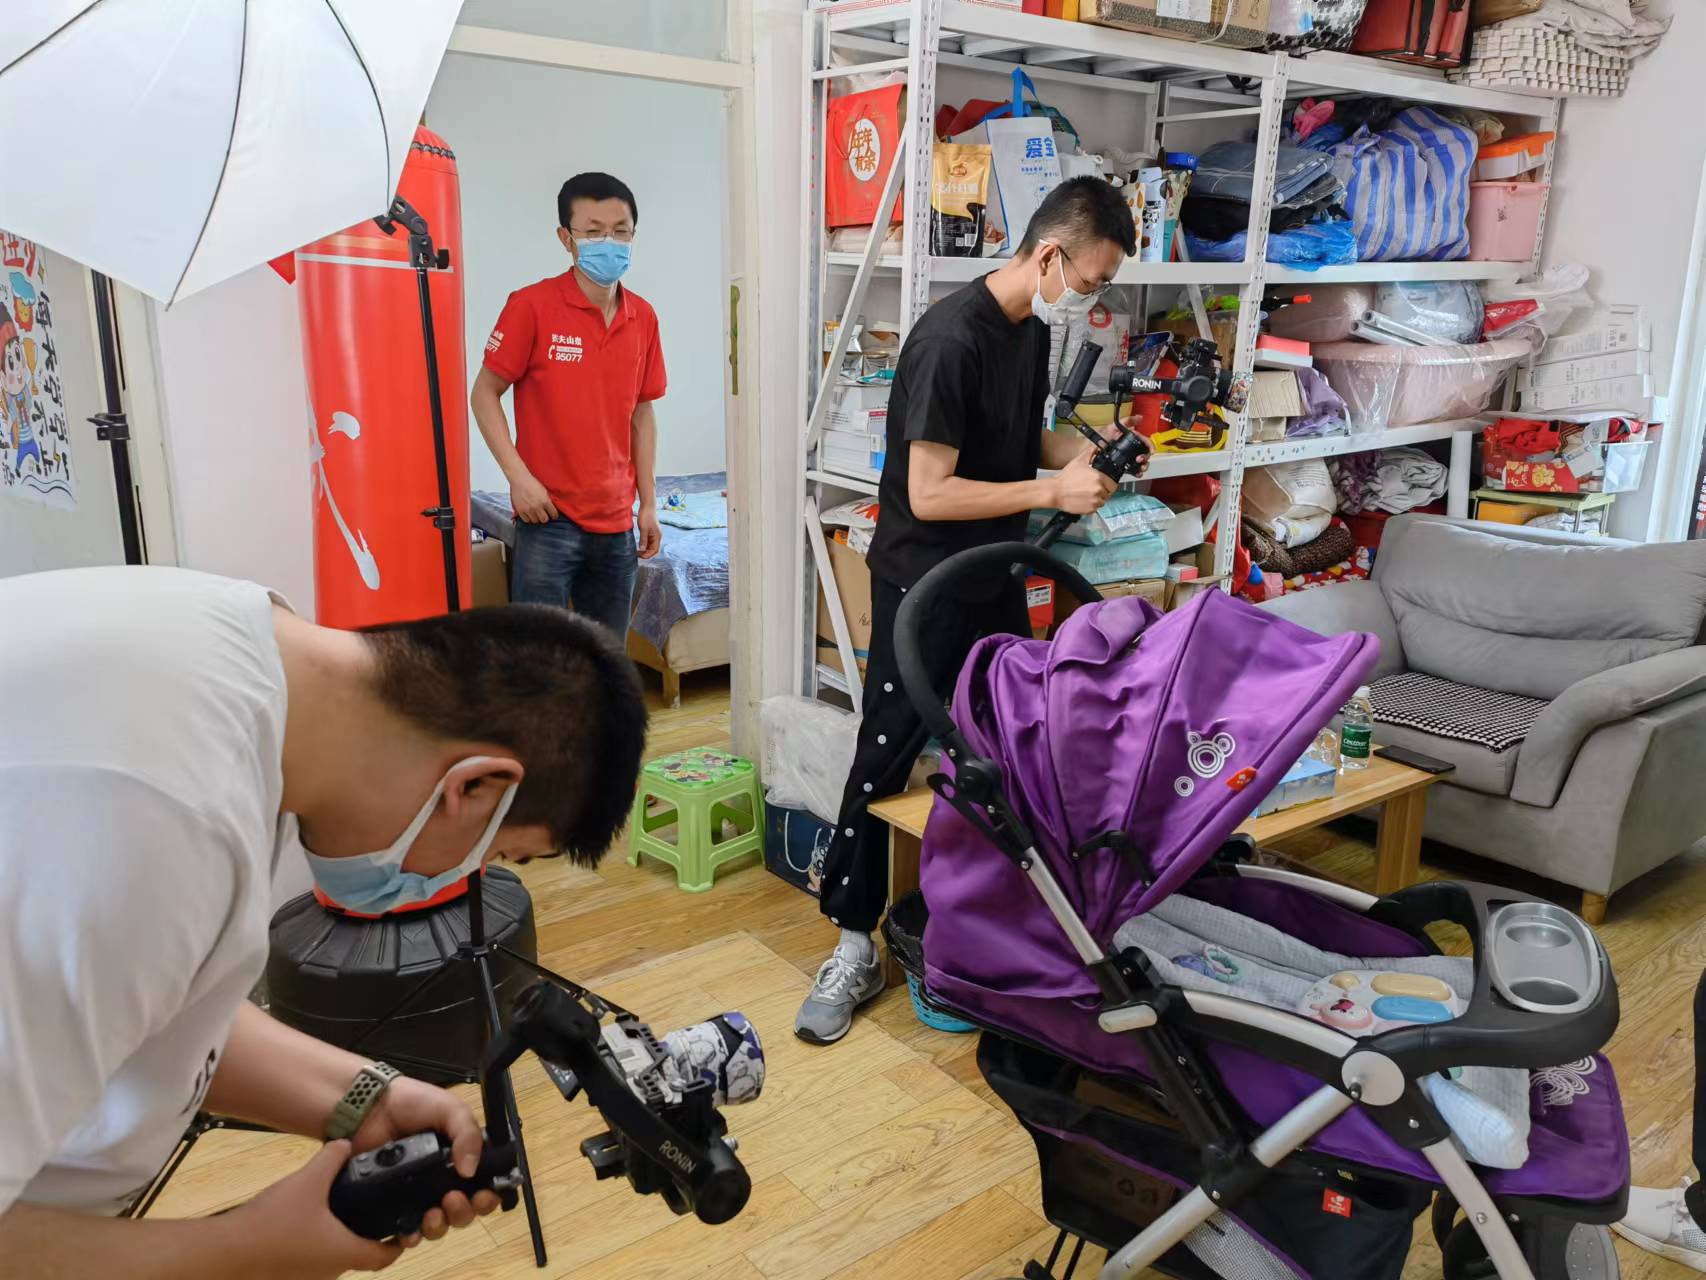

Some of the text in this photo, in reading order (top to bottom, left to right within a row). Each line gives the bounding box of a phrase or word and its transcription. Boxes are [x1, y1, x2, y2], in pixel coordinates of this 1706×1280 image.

[555, 352, 583, 363] 95077
[1132, 377, 1162, 390] RONIN
[658, 1139, 697, 1175] RONIN
